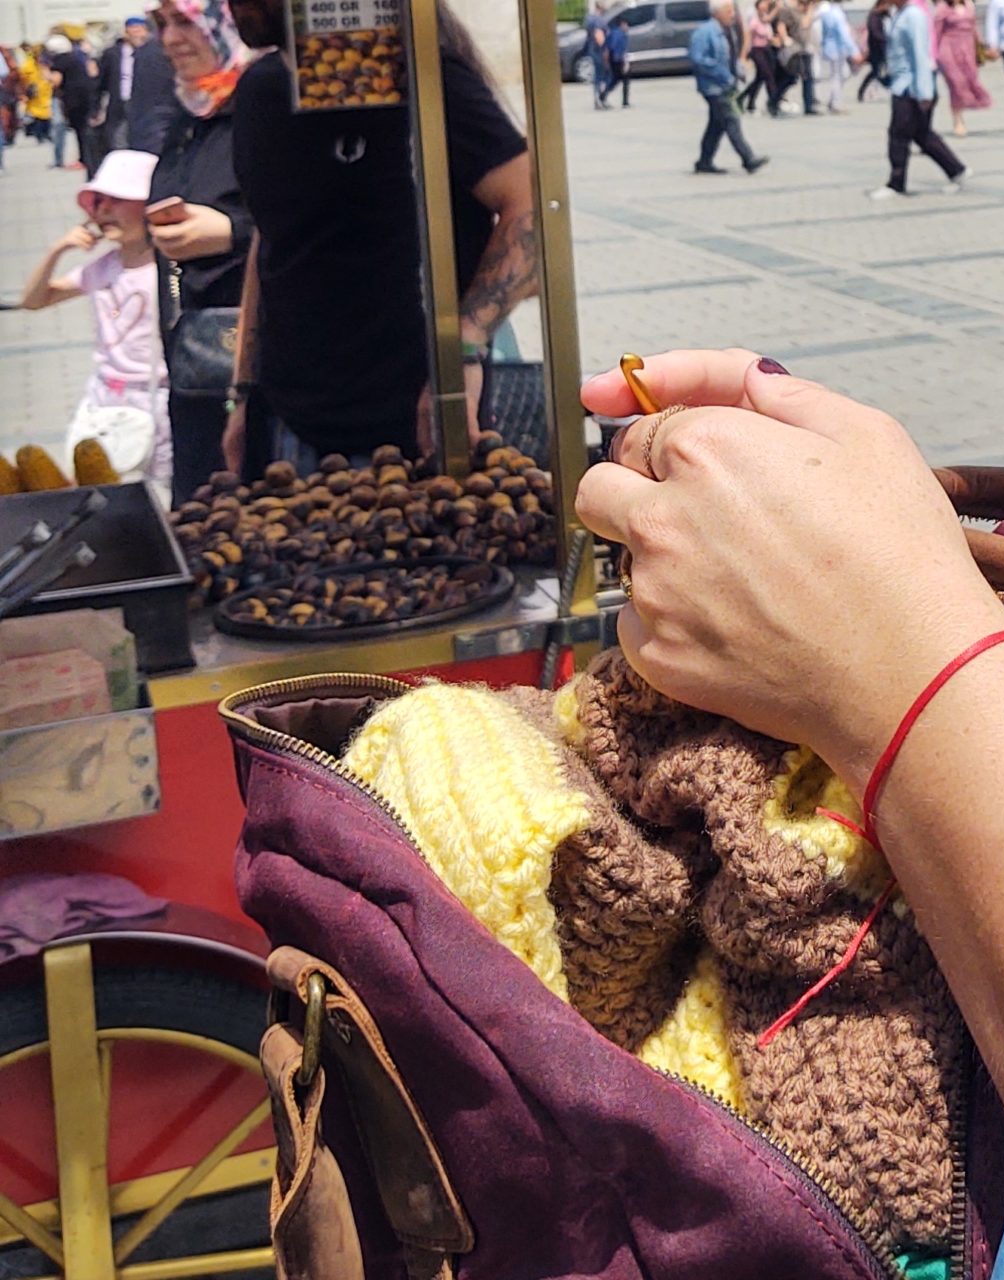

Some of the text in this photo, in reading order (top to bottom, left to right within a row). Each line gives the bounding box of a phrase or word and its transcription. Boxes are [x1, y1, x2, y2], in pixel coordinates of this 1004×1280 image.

[311, 0, 399, 13] 400 GR 160
[312, 15, 400, 28] 500 GR 200
